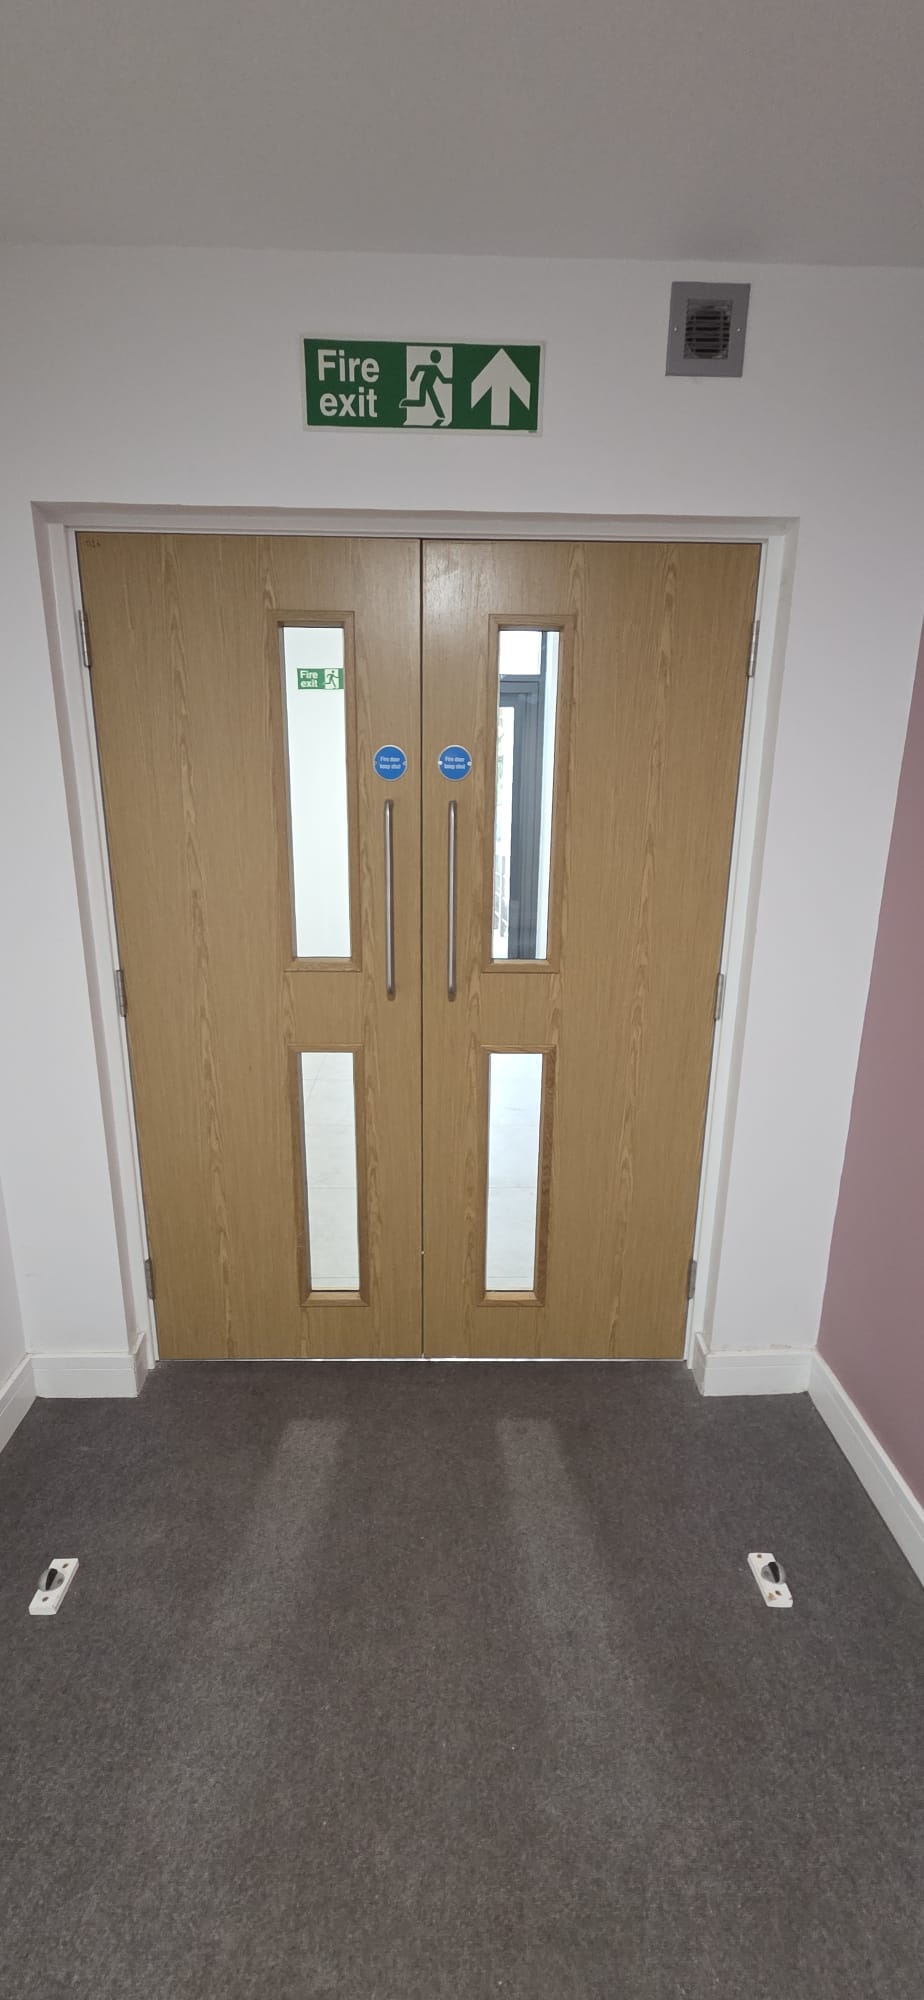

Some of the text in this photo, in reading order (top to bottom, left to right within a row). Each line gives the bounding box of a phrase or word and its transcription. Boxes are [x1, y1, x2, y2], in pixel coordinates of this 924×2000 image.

[318, 349, 380, 383] Fire
[319, 386, 378, 417] exit
[300, 670, 318, 679] Fire
[300, 679, 318, 688] exit
